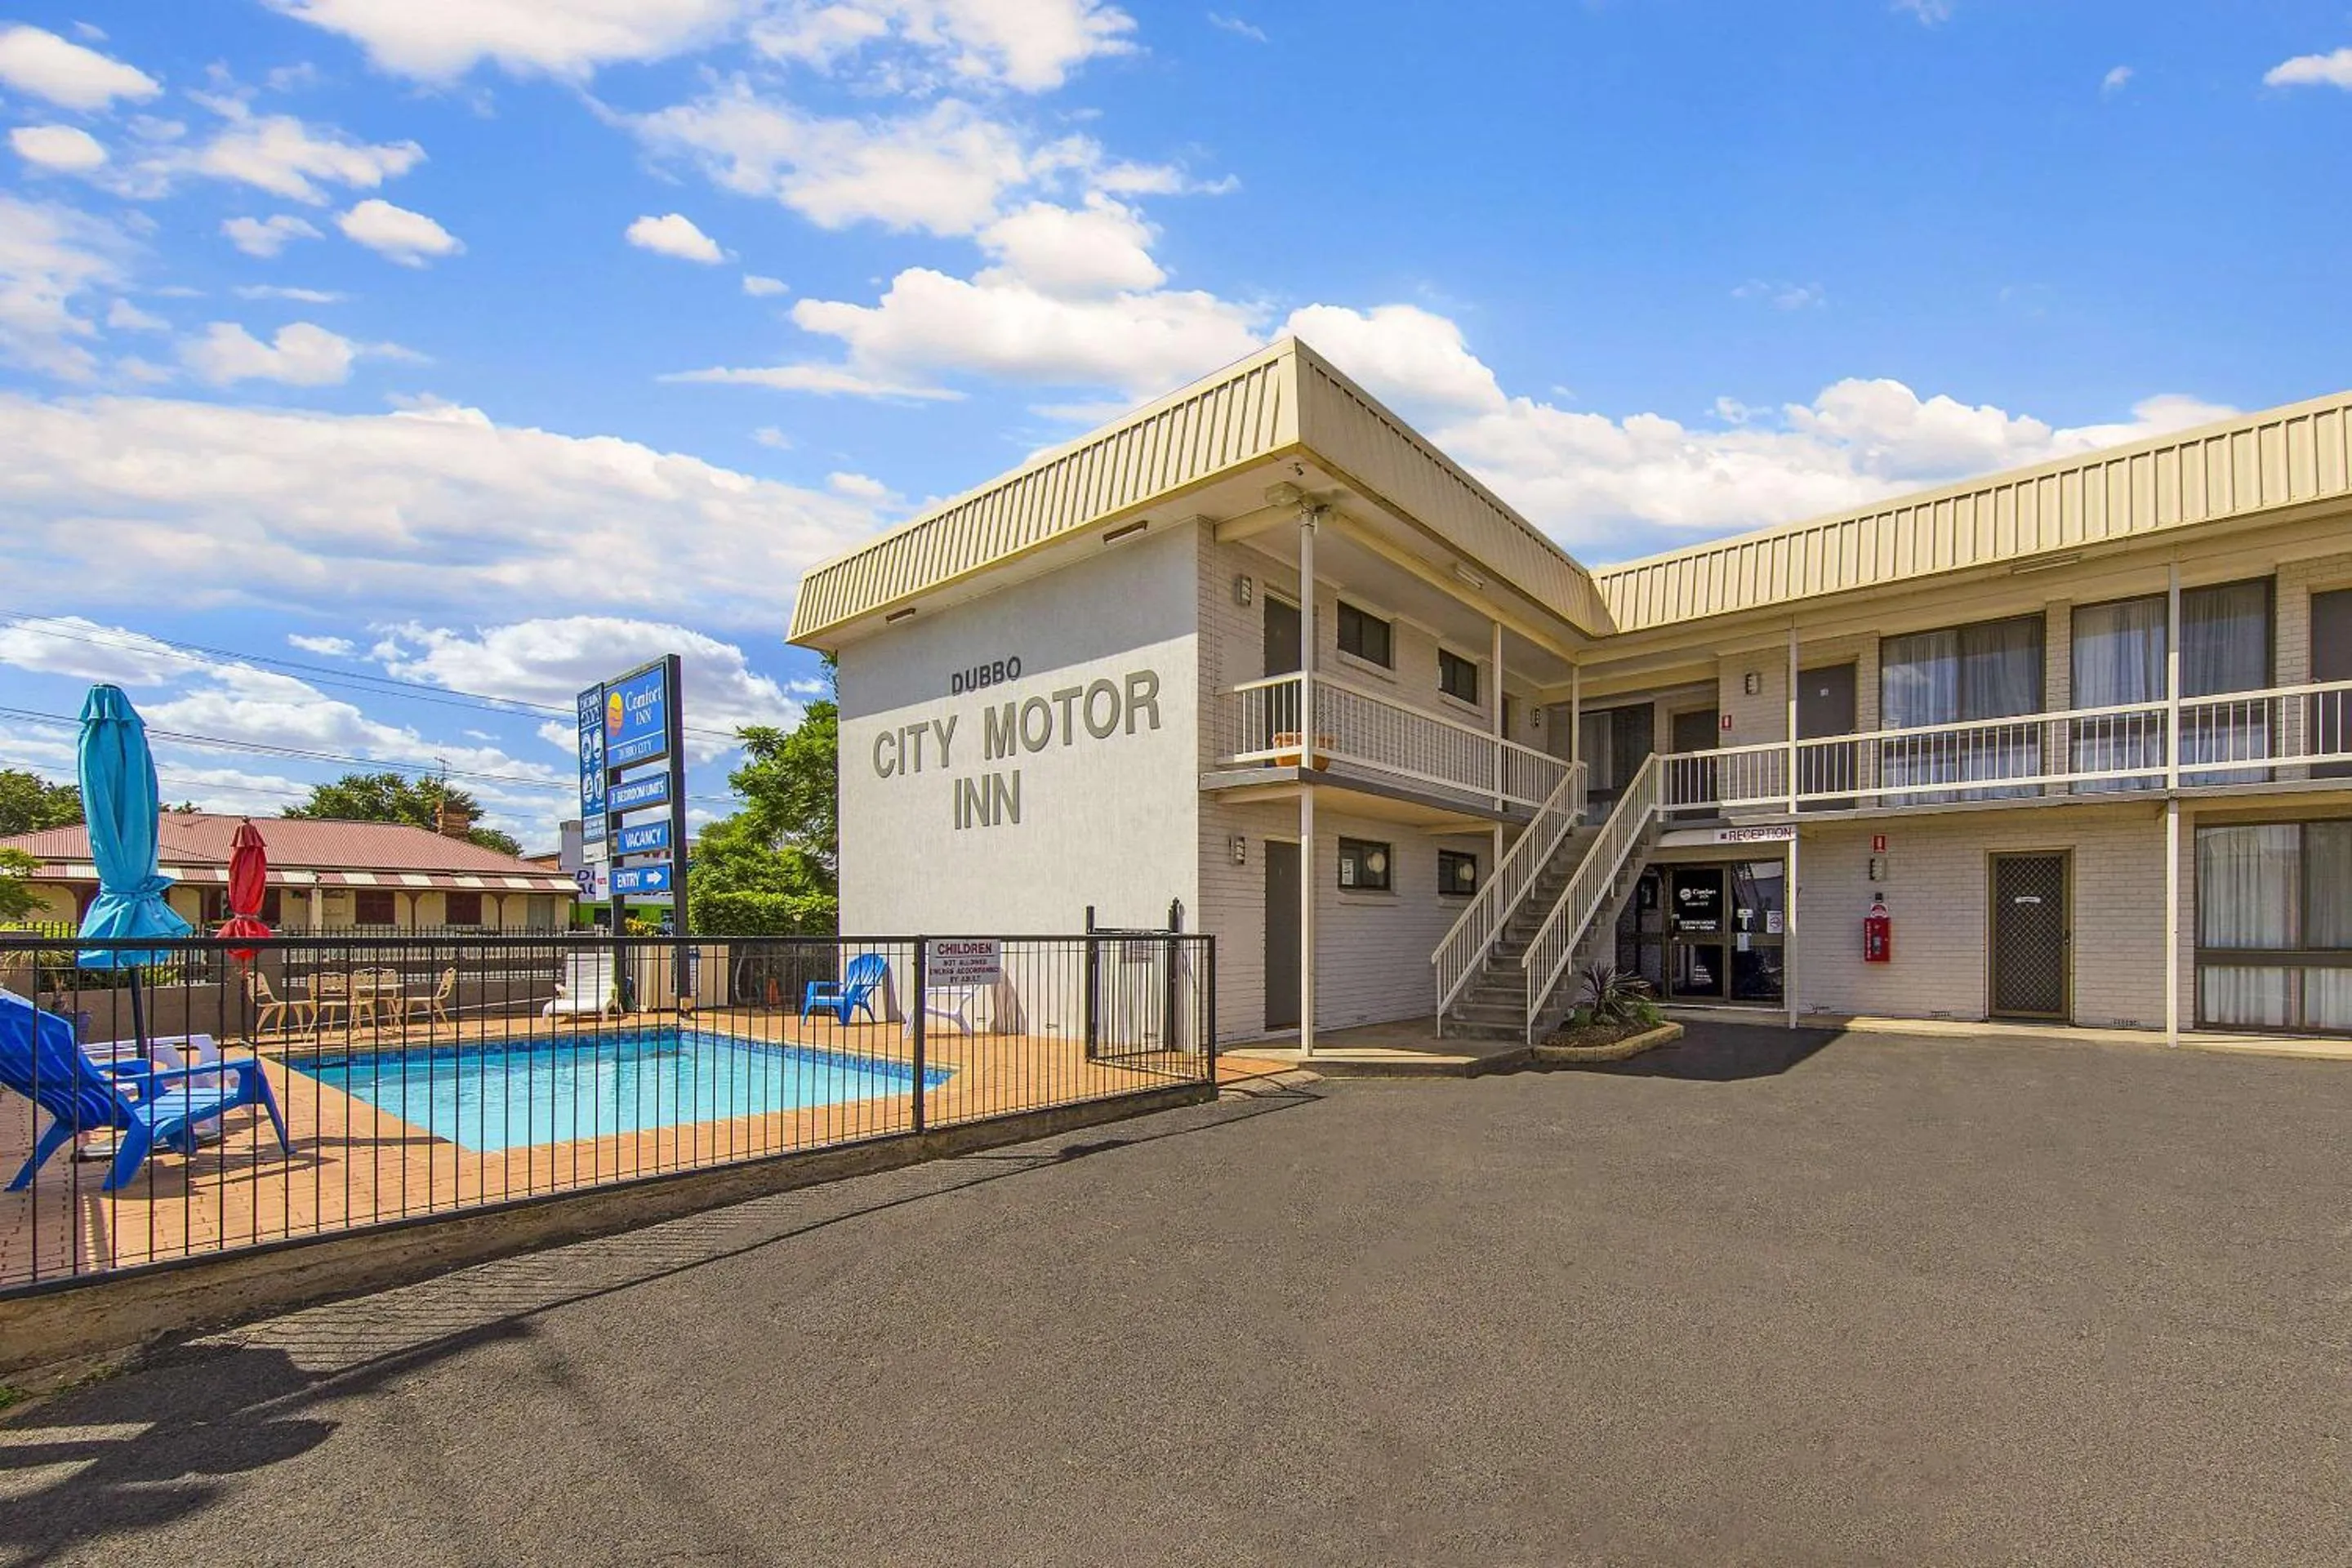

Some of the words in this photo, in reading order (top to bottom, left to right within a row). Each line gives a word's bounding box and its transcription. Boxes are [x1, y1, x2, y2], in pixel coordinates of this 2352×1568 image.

[951, 656, 1021, 696] DUBBO
[625, 684, 662, 711] Comfort
[635, 707, 652, 727] INN
[873, 715, 958, 778] CITY
[984, 669, 1161, 761] MOTOR
[954, 769, 1021, 831] INN
[625, 827, 662, 849] VACANCY
[1729, 827, 1792, 841] RECEPTION
[617, 871, 641, 889] ENTRY
[937, 942, 992, 956] CHILDREN
